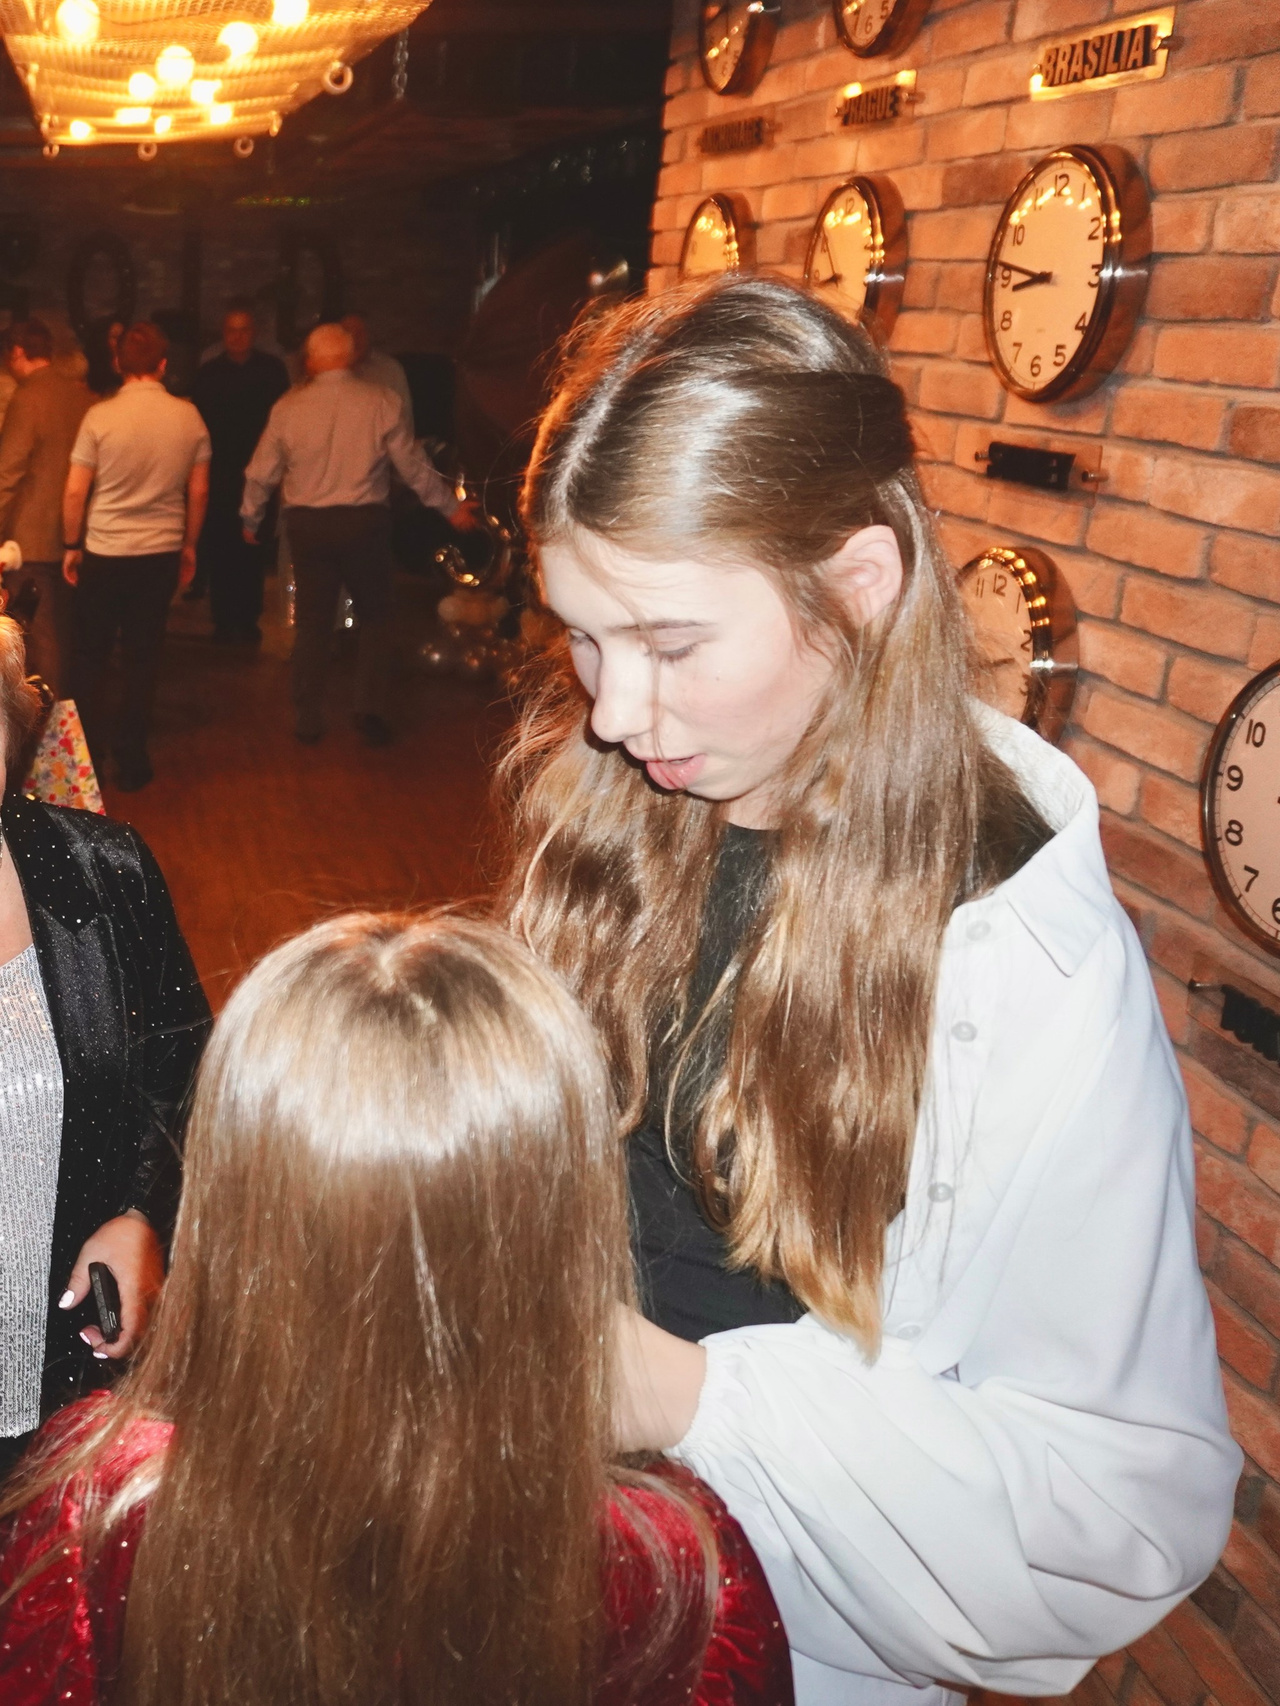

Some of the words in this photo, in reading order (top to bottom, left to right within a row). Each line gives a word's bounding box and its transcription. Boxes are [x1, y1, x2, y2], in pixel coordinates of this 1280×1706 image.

[1041, 25, 1158, 87] BRASILIA
[1054, 174, 1070, 197] 12
[1012, 225, 1025, 246] 10
[1087, 217, 1101, 241] 2
[1000, 268, 1013, 289] 9
[1087, 264, 1100, 288] 3
[1000, 310, 1013, 331] 8
[1075, 312, 1088, 335] 4
[1012, 343, 1022, 363] 7
[1053, 344, 1067, 367] 5
[1030, 355, 1042, 377] 6
[975, 577, 985, 598] 11
[993, 573, 1008, 597] 12
[1021, 630, 1032, 652] 2
[1246, 718, 1266, 748] 10
[1225, 765, 1244, 791] 9
[1225, 819, 1244, 847] 8
[1243, 864, 1260, 893] 7
